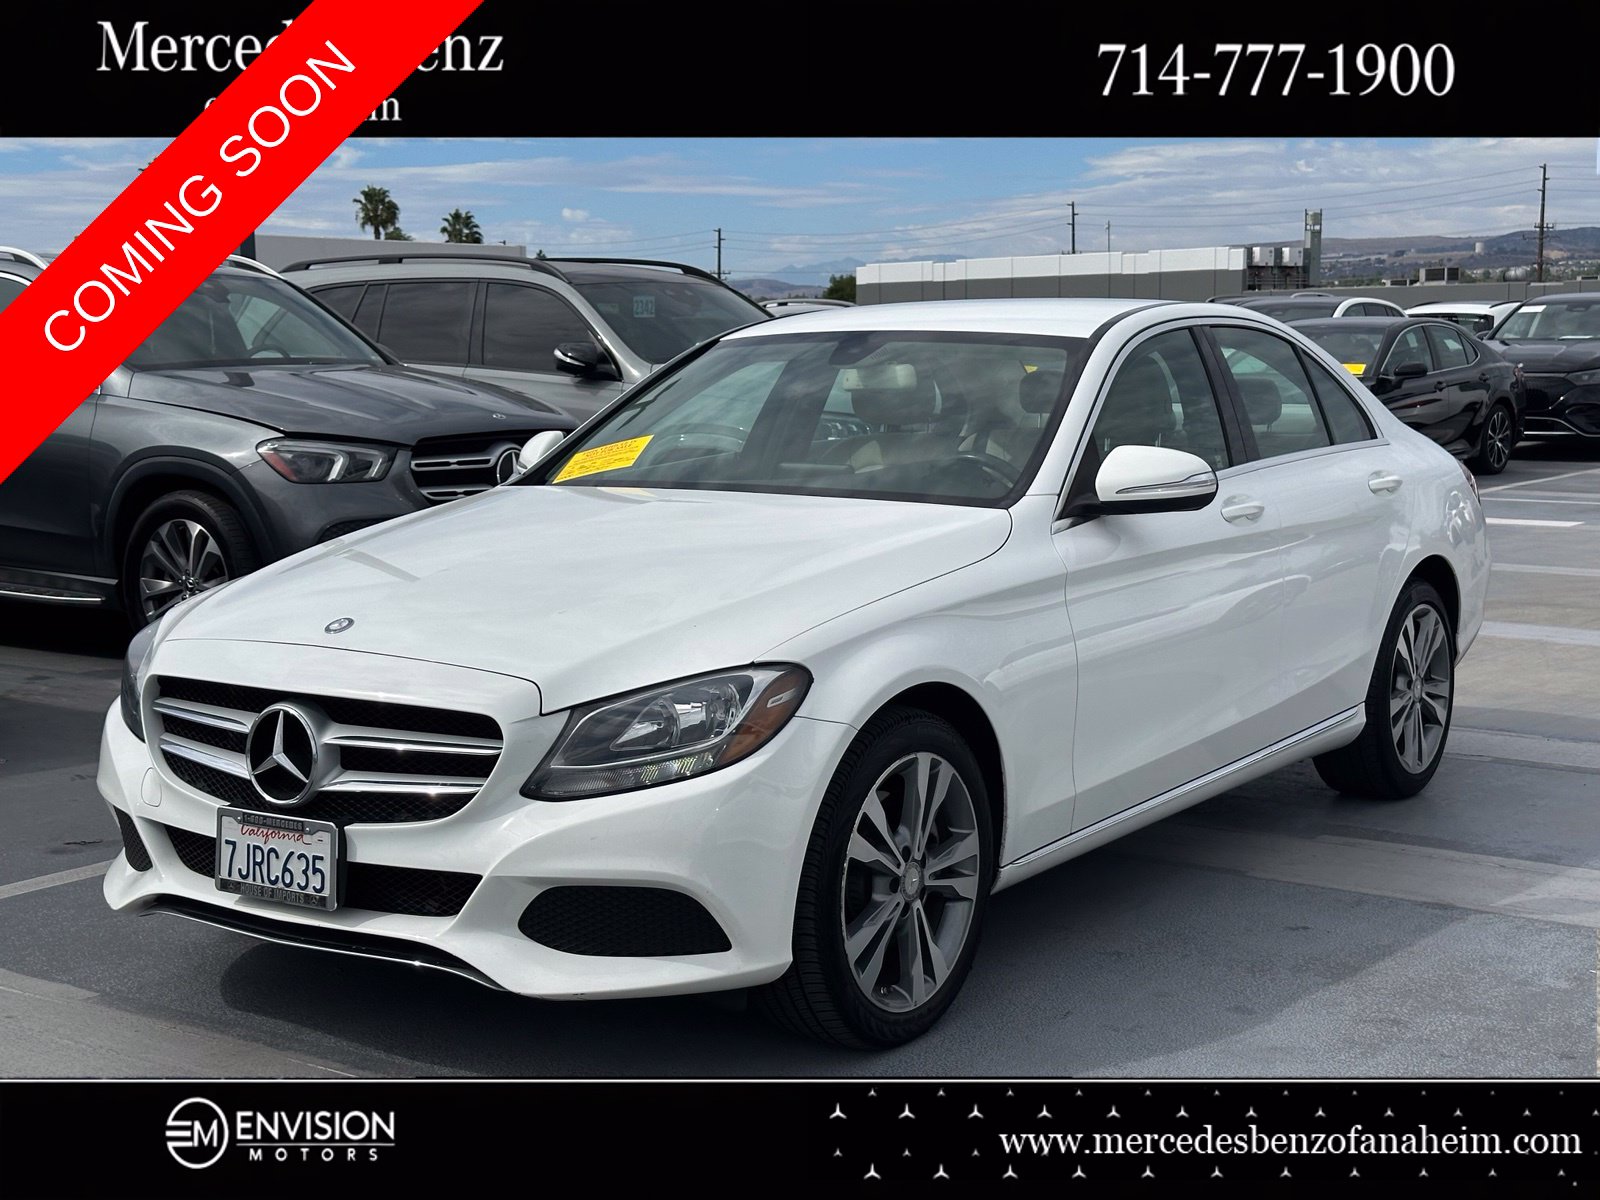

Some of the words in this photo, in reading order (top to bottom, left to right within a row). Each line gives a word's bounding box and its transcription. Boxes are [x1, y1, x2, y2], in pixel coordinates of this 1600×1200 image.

[240, 825, 312, 845] California
[224, 838, 326, 894] 7JRC635
[239, 883, 262, 896] HOUSE
[263, 886, 273, 898] OF
[273, 889, 305, 905] IMPORTS
